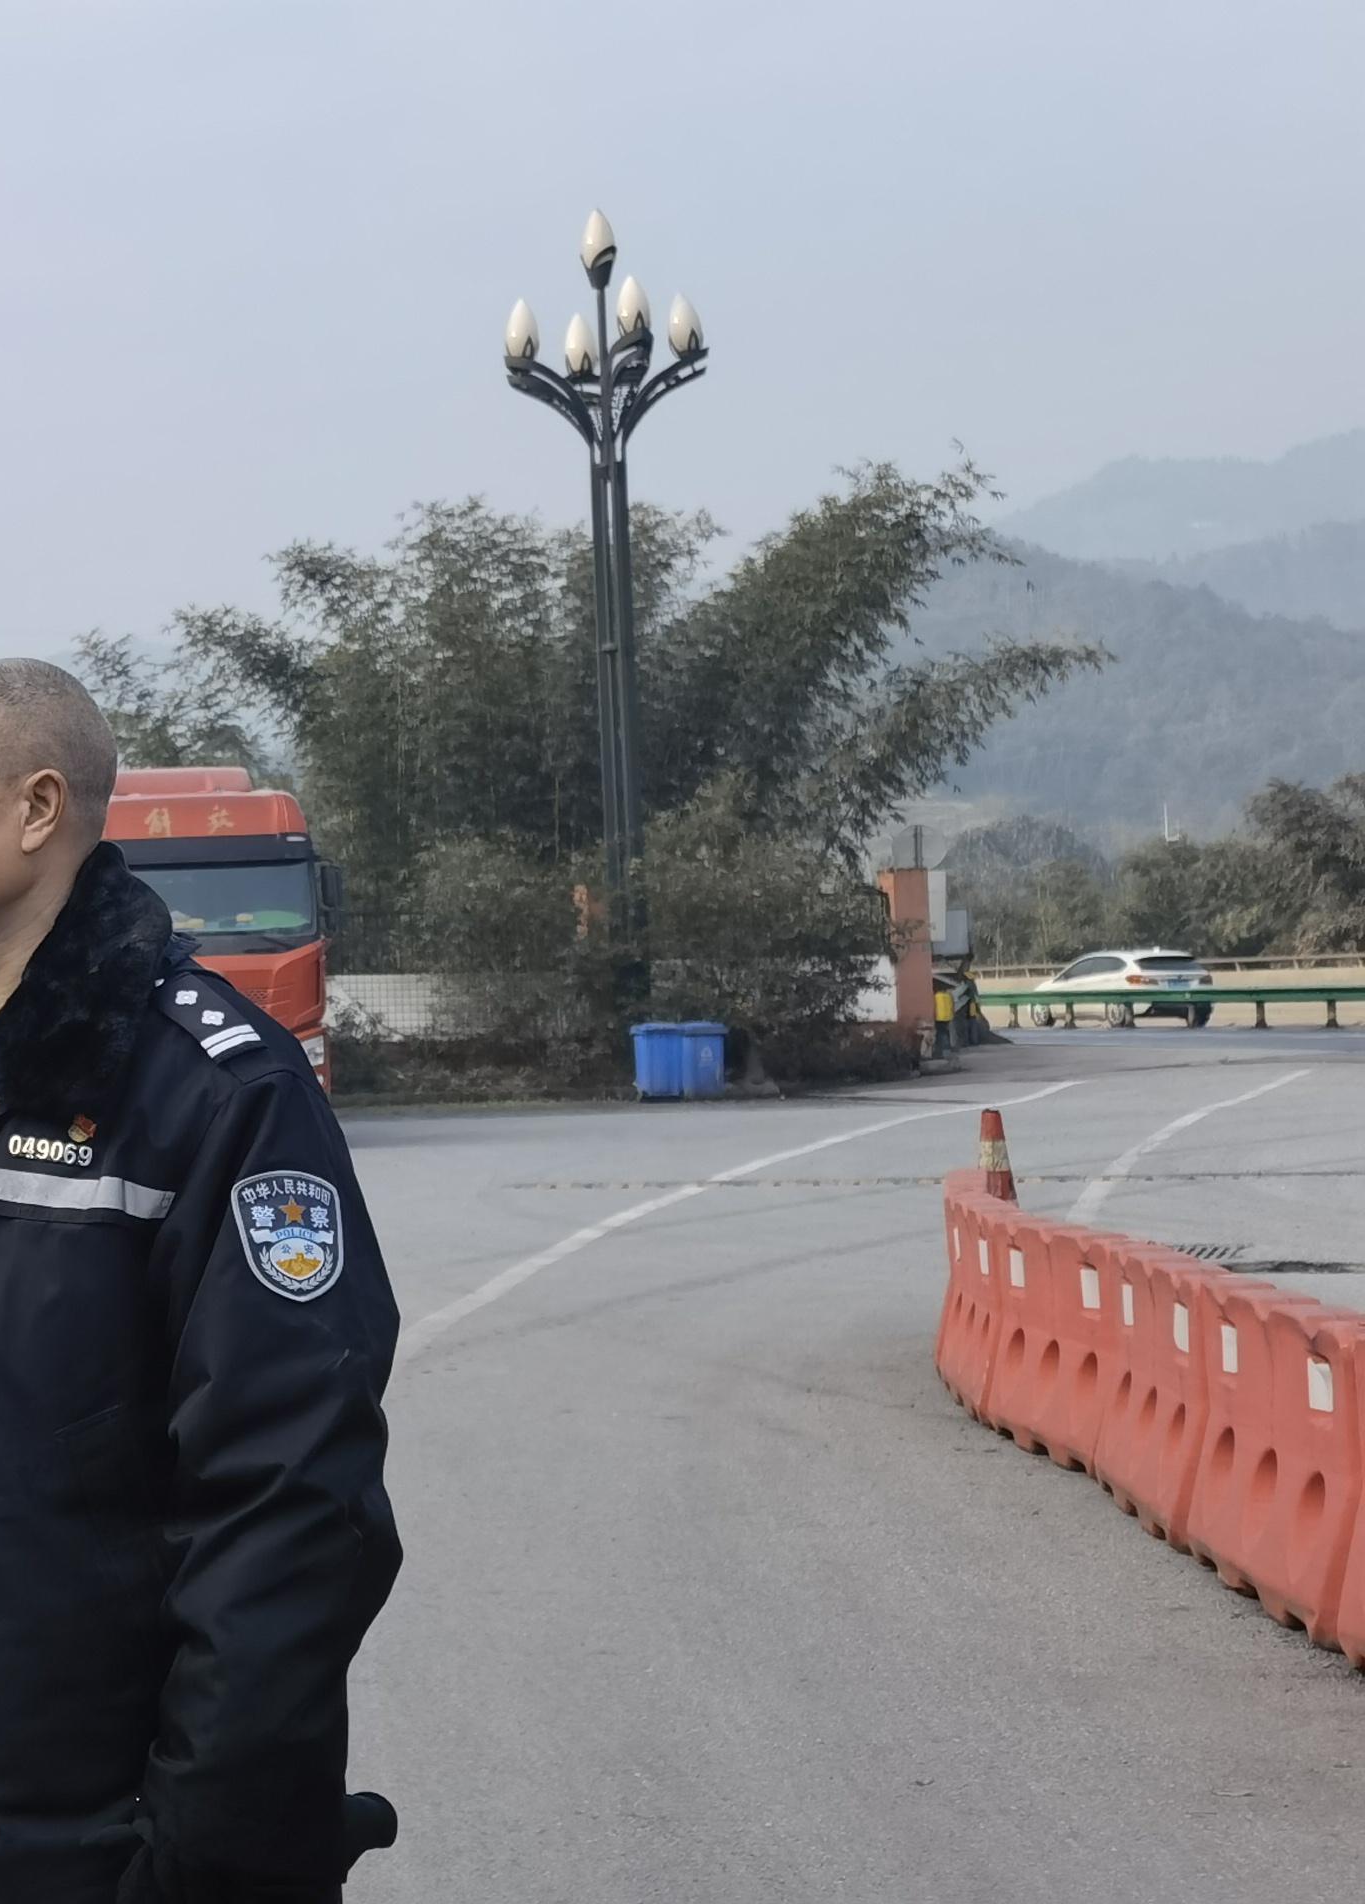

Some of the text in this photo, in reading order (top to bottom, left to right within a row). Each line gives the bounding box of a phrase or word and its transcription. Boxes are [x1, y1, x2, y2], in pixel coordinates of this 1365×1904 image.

[9, 1134, 93, 1167] 049069
[241, 1178, 331, 1206] 中华人民共和国
